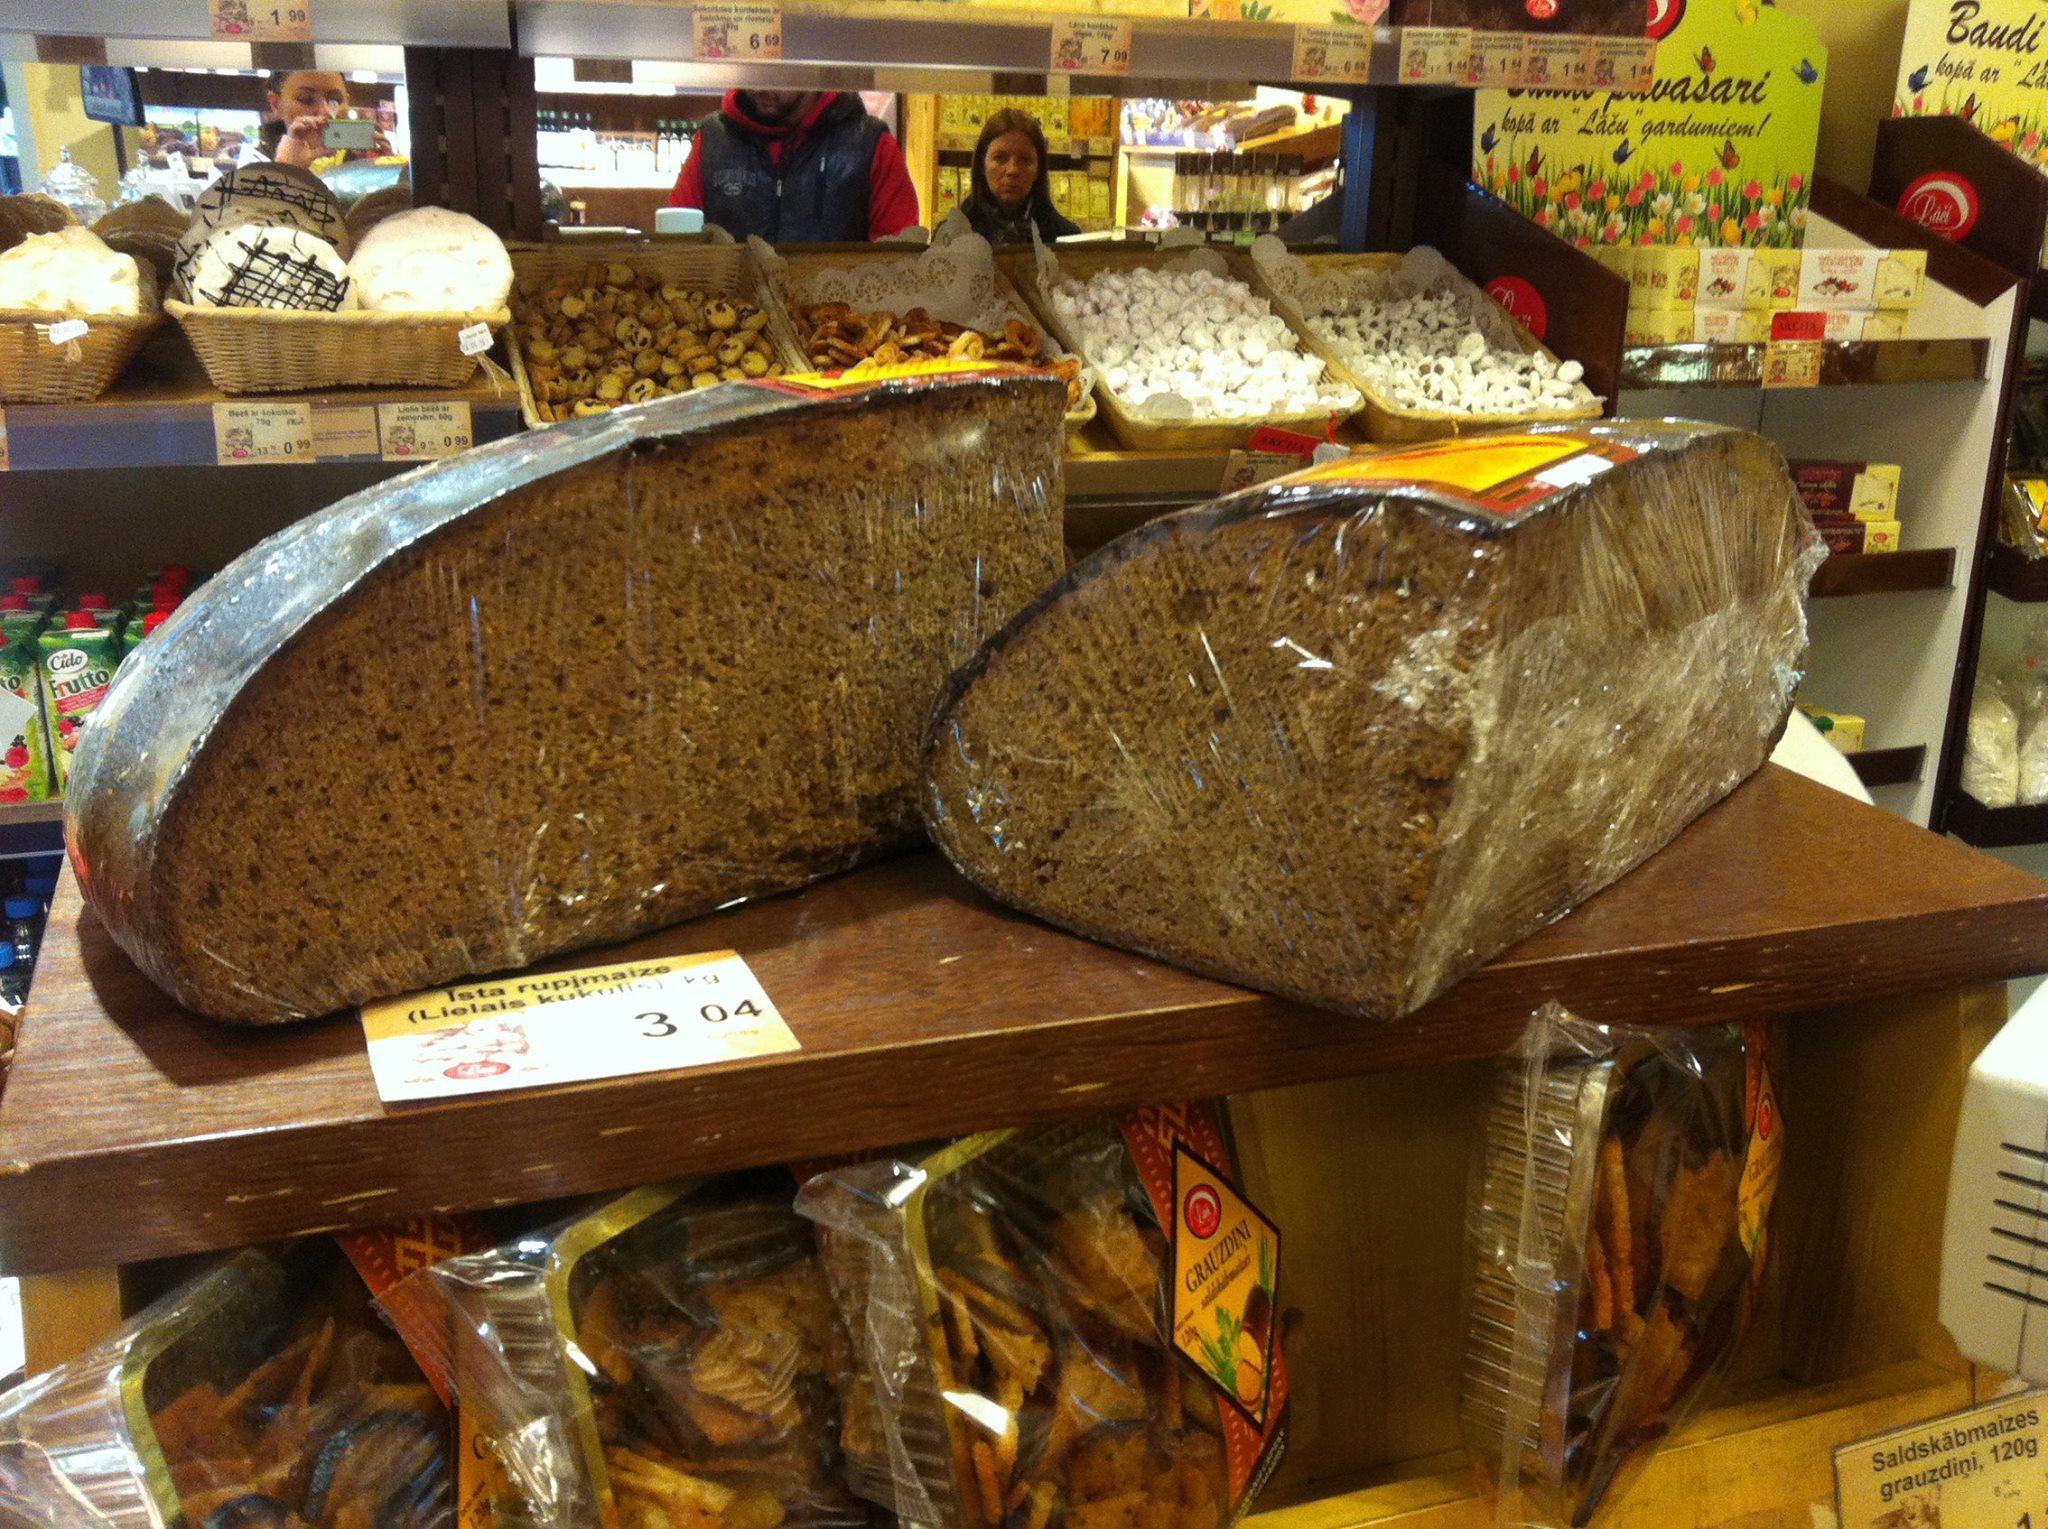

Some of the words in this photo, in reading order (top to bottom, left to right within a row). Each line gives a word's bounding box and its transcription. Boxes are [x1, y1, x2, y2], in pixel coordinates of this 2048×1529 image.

[270, 9, 280, 26] 1
[288, 9, 306, 22] 99
[1946, 0, 2046, 54] Baudi
[750, 33, 760, 49] 6
[1101, 48, 1110, 64] 7
[1935, 51, 1976, 86] kopā
[1980, 66, 2000, 84] ar
[1501, 106, 1536, 138] kopā
[1541, 118, 1560, 134] ar
[1640, 112, 1772, 145] gardumiem!
[283, 441, 293, 455] 0
[296, 439, 310, 449] 99
[444, 435, 452, 448] 0
[454, 435, 469, 446] 99
[50, 652, 84, 672] Cido
[48, 669, 110, 699] Frutto
[518, 965, 672, 994] rupjmaize
[408, 999, 527, 1024] (Lielais
[634, 1011, 678, 1038] 3
[700, 999, 763, 1023] 04
[1185, 1218, 1252, 1293] GRAUZDIŅI
[1872, 1409, 2040, 1472] Saldskābmaizes
[1880, 1450, 1984, 1502] grauzdiņi,
[1991, 1436, 2039, 1464] 120g
